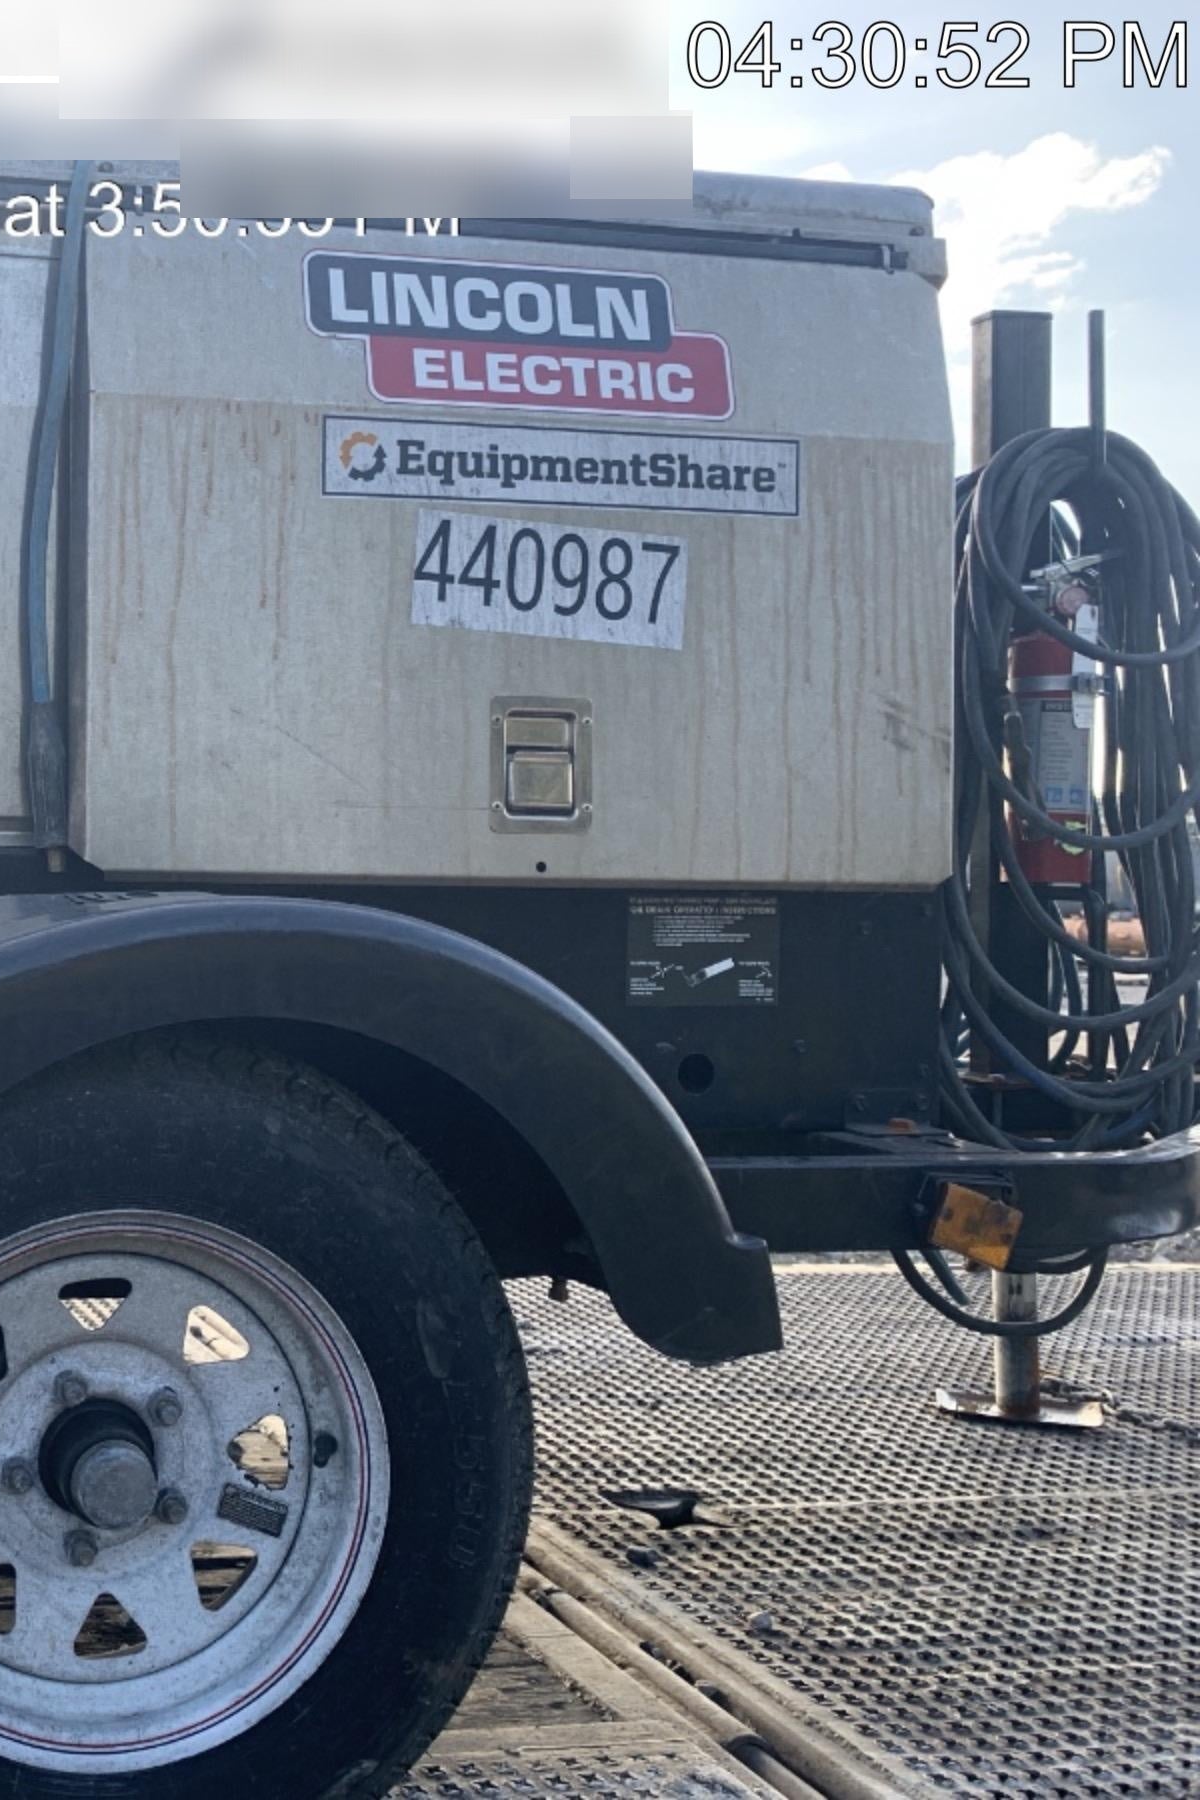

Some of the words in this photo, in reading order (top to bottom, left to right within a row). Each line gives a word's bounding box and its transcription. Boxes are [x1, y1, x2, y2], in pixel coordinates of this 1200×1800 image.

[329, 267, 651, 341] LINCOLN
[413, 347, 695, 402] ELECTRIC
[413, 518, 681, 626] 440987
